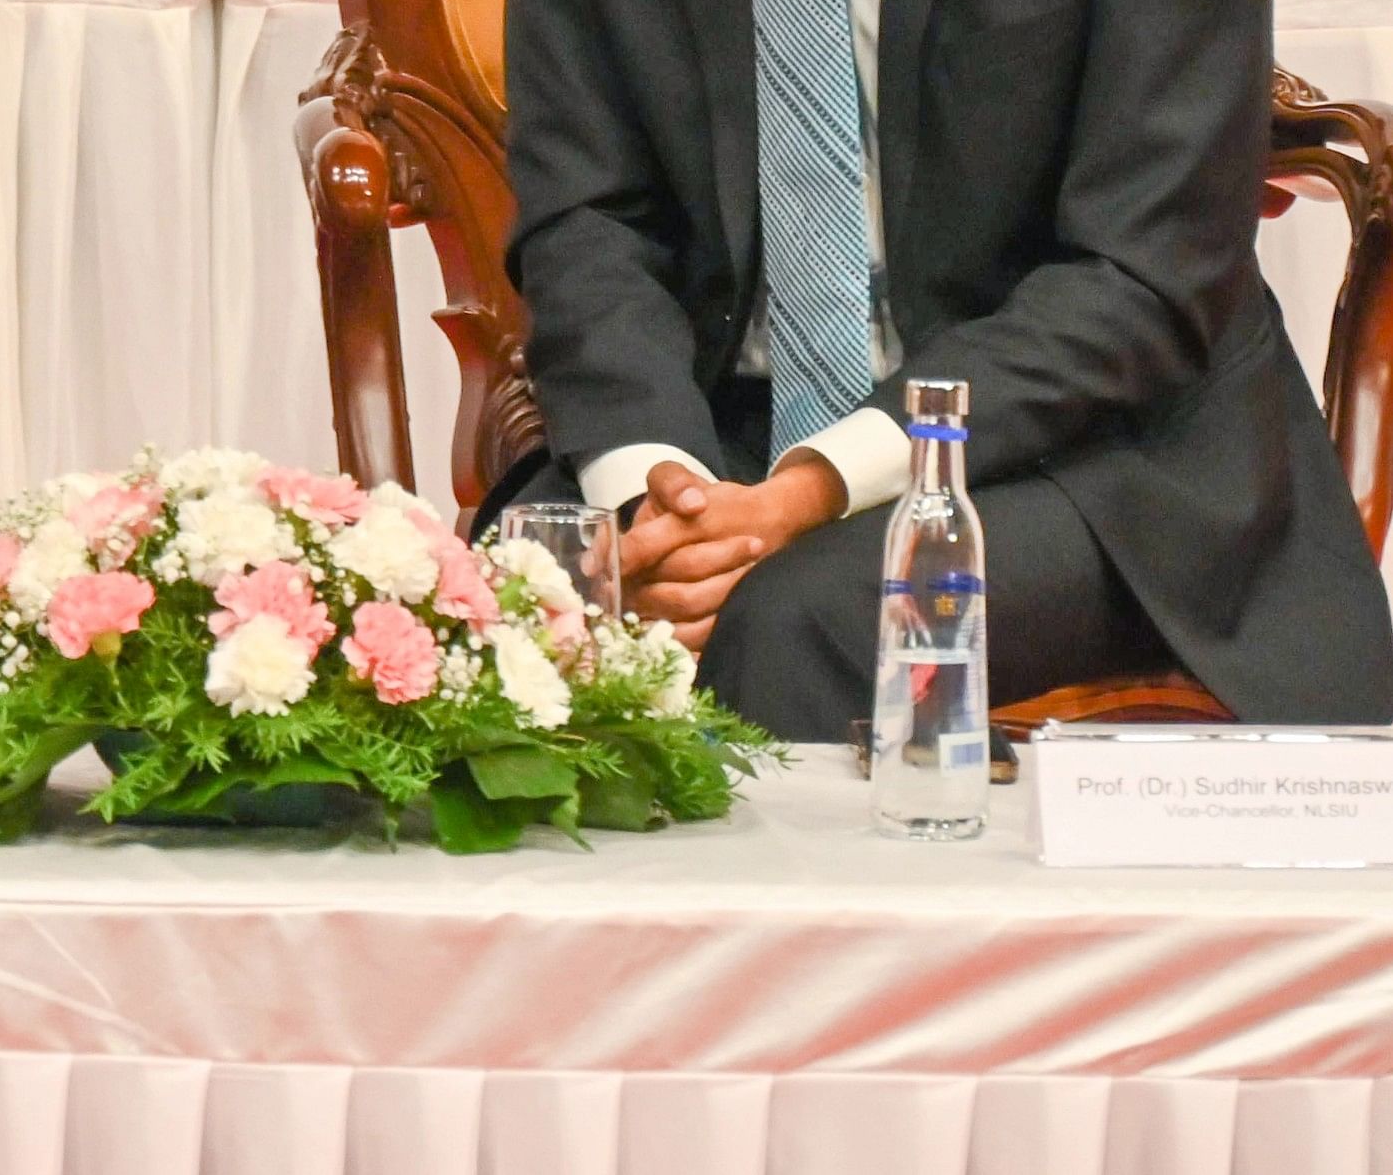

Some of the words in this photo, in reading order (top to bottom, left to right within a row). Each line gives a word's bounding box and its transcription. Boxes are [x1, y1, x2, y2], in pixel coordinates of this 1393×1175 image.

[1078, 777, 1130, 796] Prof.
[1139, 777, 1188, 799] (Dr.)
[1195, 777, 1268, 796] Sudhir
[1304, 804, 1359, 819] NLSIU
